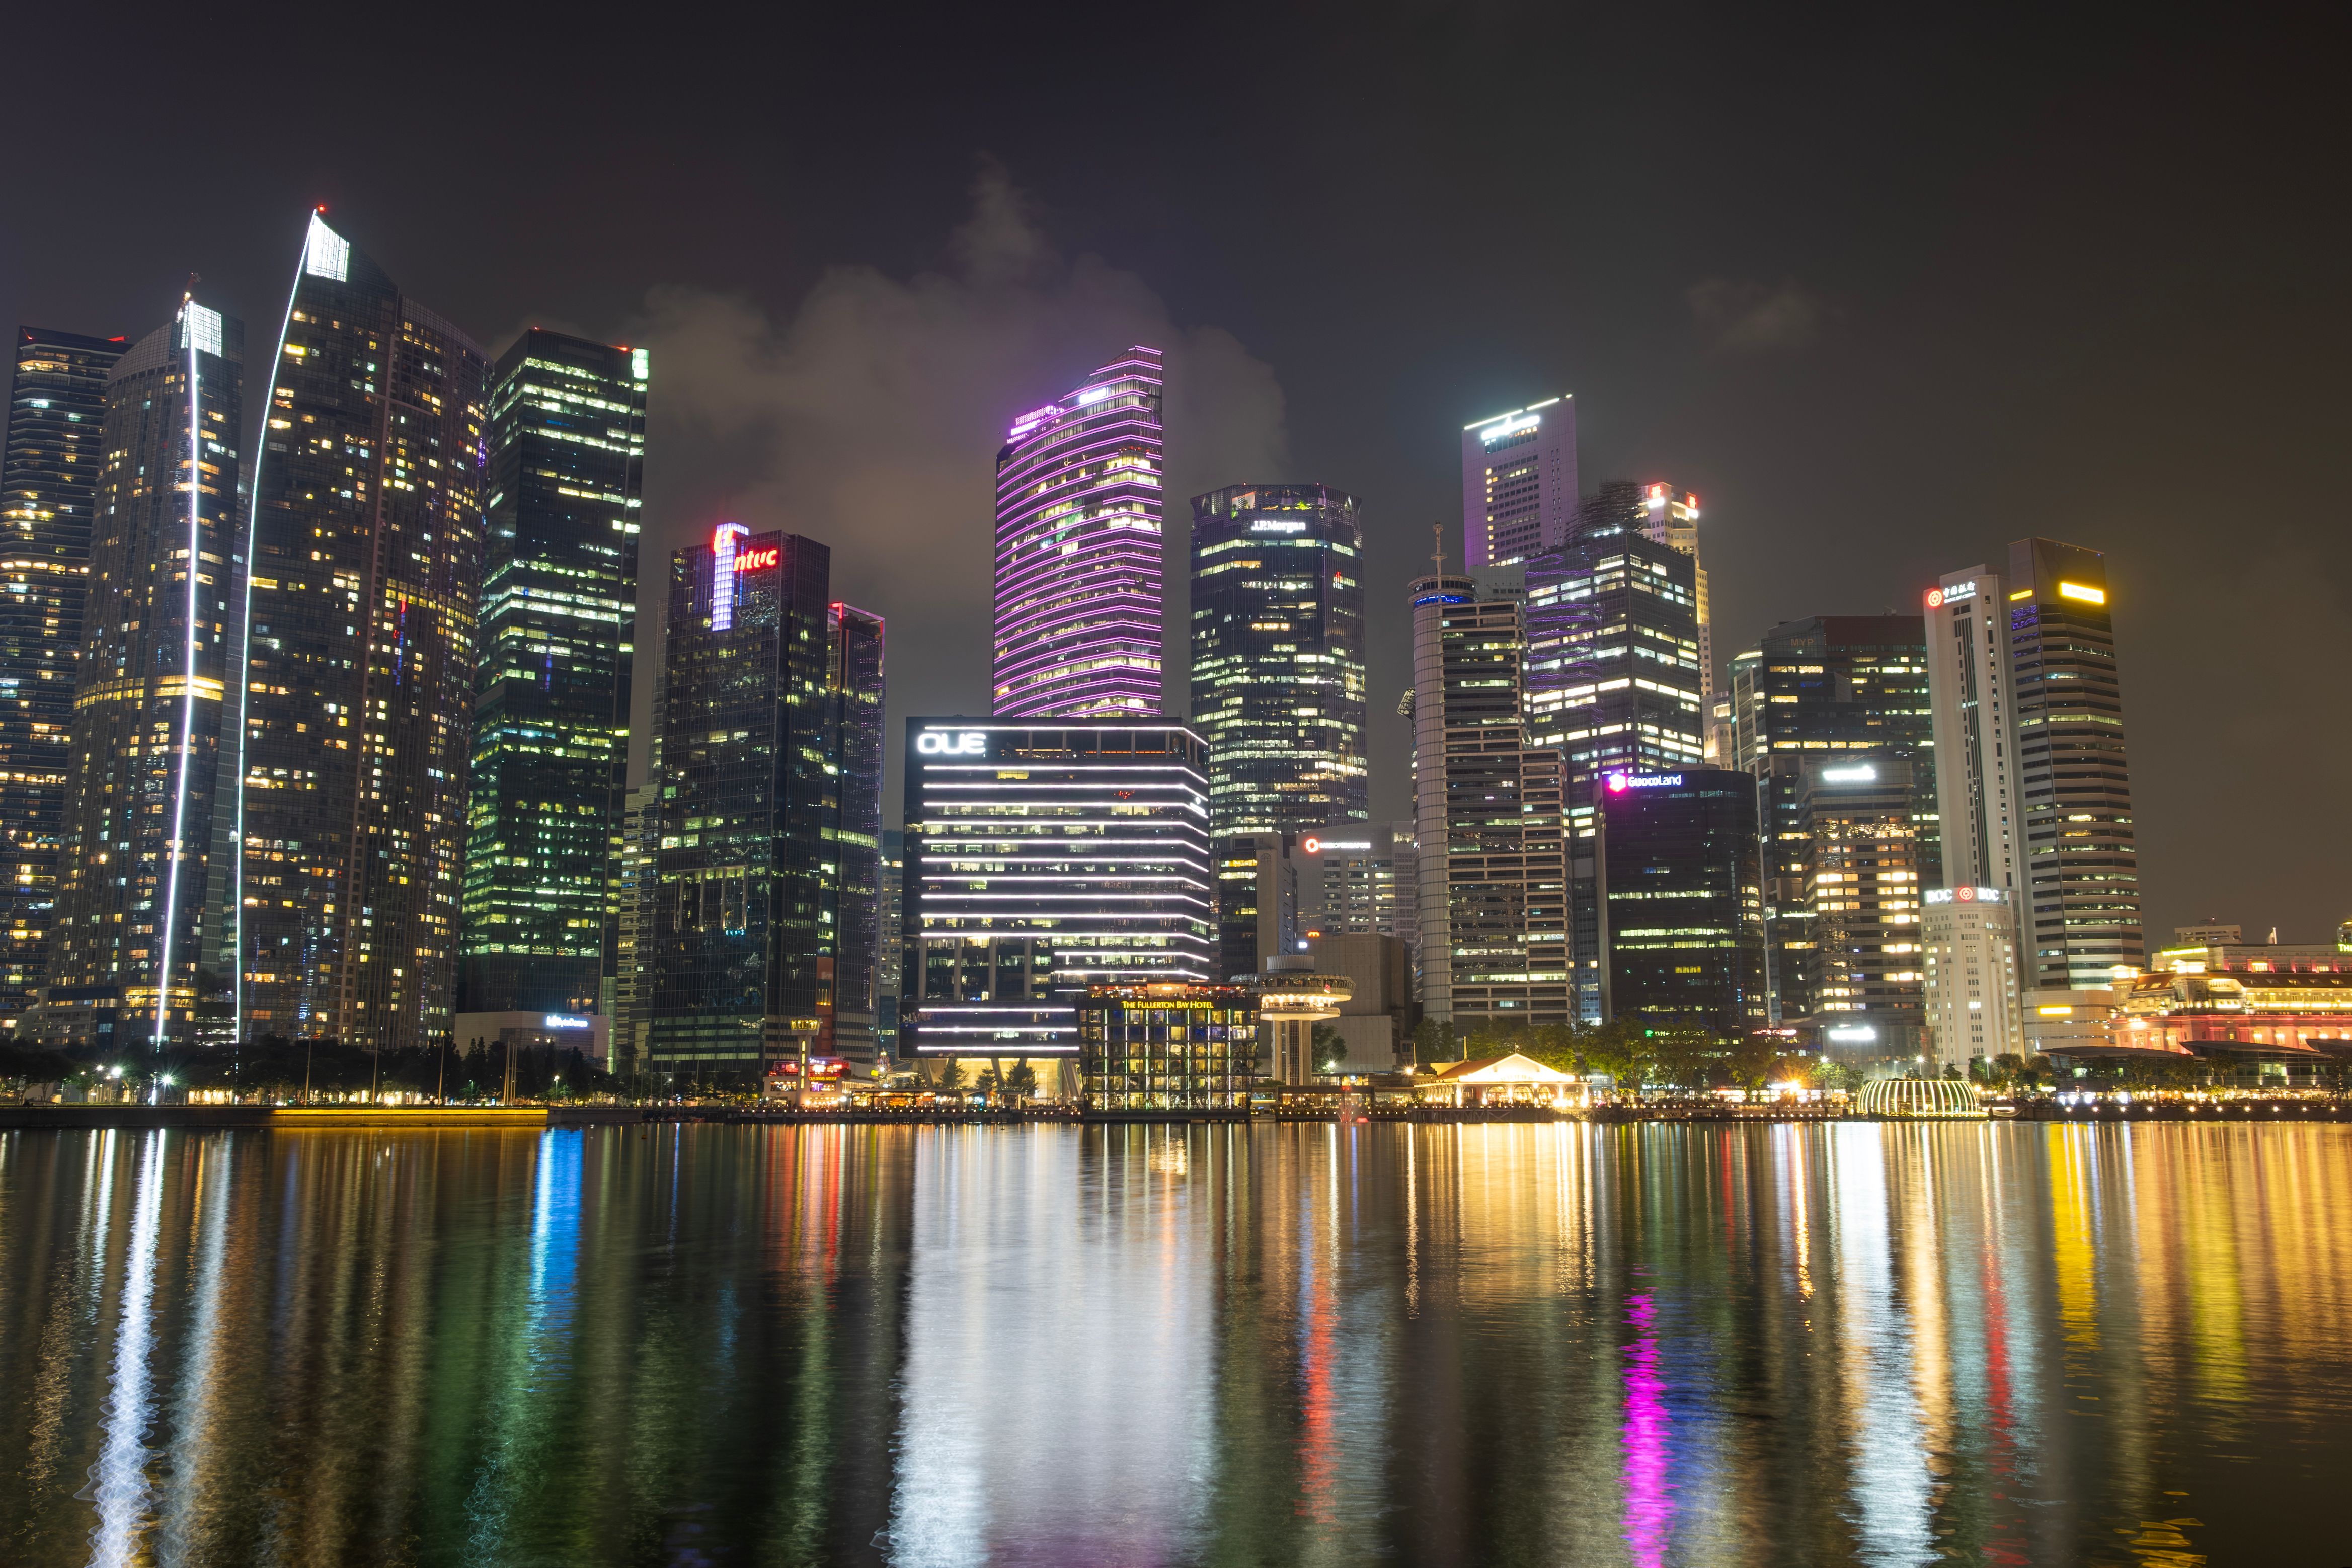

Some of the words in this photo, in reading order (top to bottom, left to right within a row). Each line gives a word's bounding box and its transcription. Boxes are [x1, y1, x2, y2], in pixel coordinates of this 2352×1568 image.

[733, 550, 778, 572] ntuc
[917, 733, 986, 753] OUE
[1627, 774, 1682, 787] GuocoLand
[1926, 889, 1953, 902] BOC
[1977, 888, 1999, 901] BOC
[1121, 1001, 1136, 1009] THE
[1137, 1001, 1175, 1009] FULLERTON
[1177, 1001, 1189, 1009] BAY
[1190, 1001, 1214, 1009] HOTEL
